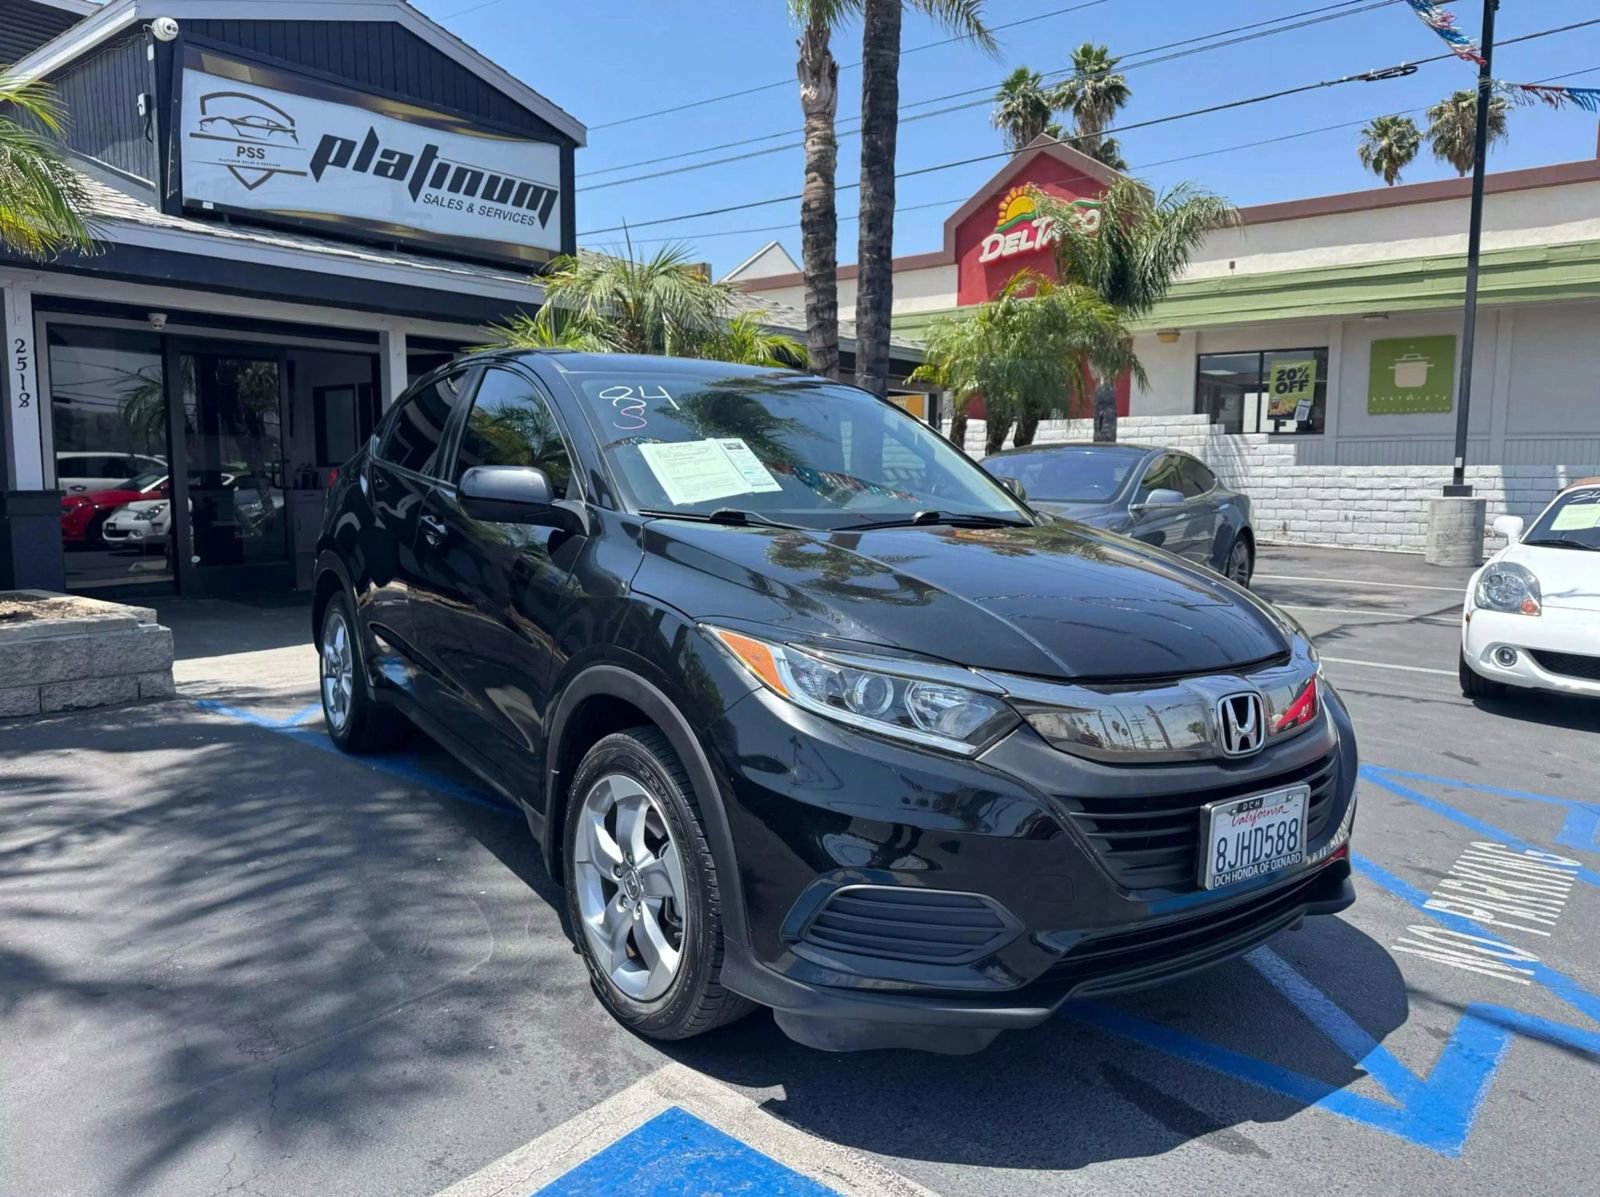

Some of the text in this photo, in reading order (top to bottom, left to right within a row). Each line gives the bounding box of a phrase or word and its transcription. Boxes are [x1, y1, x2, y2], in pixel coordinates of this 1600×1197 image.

[236, 145, 265, 160] PSS
[422, 193, 536, 227] SALES & SERVICES
[978, 229, 1034, 263] DEL
[14, 338, 31, 408] 2518
[1274, 379, 1310, 395] OFF
[1275, 366, 1311, 382] 20%
[1231, 805, 1291, 828] California
[1242, 801, 1261, 811] DCH
[1215, 818, 1300, 873] 8JHD588
[1214, 852, 1302, 888] DCH HONDA OF OXNARD
